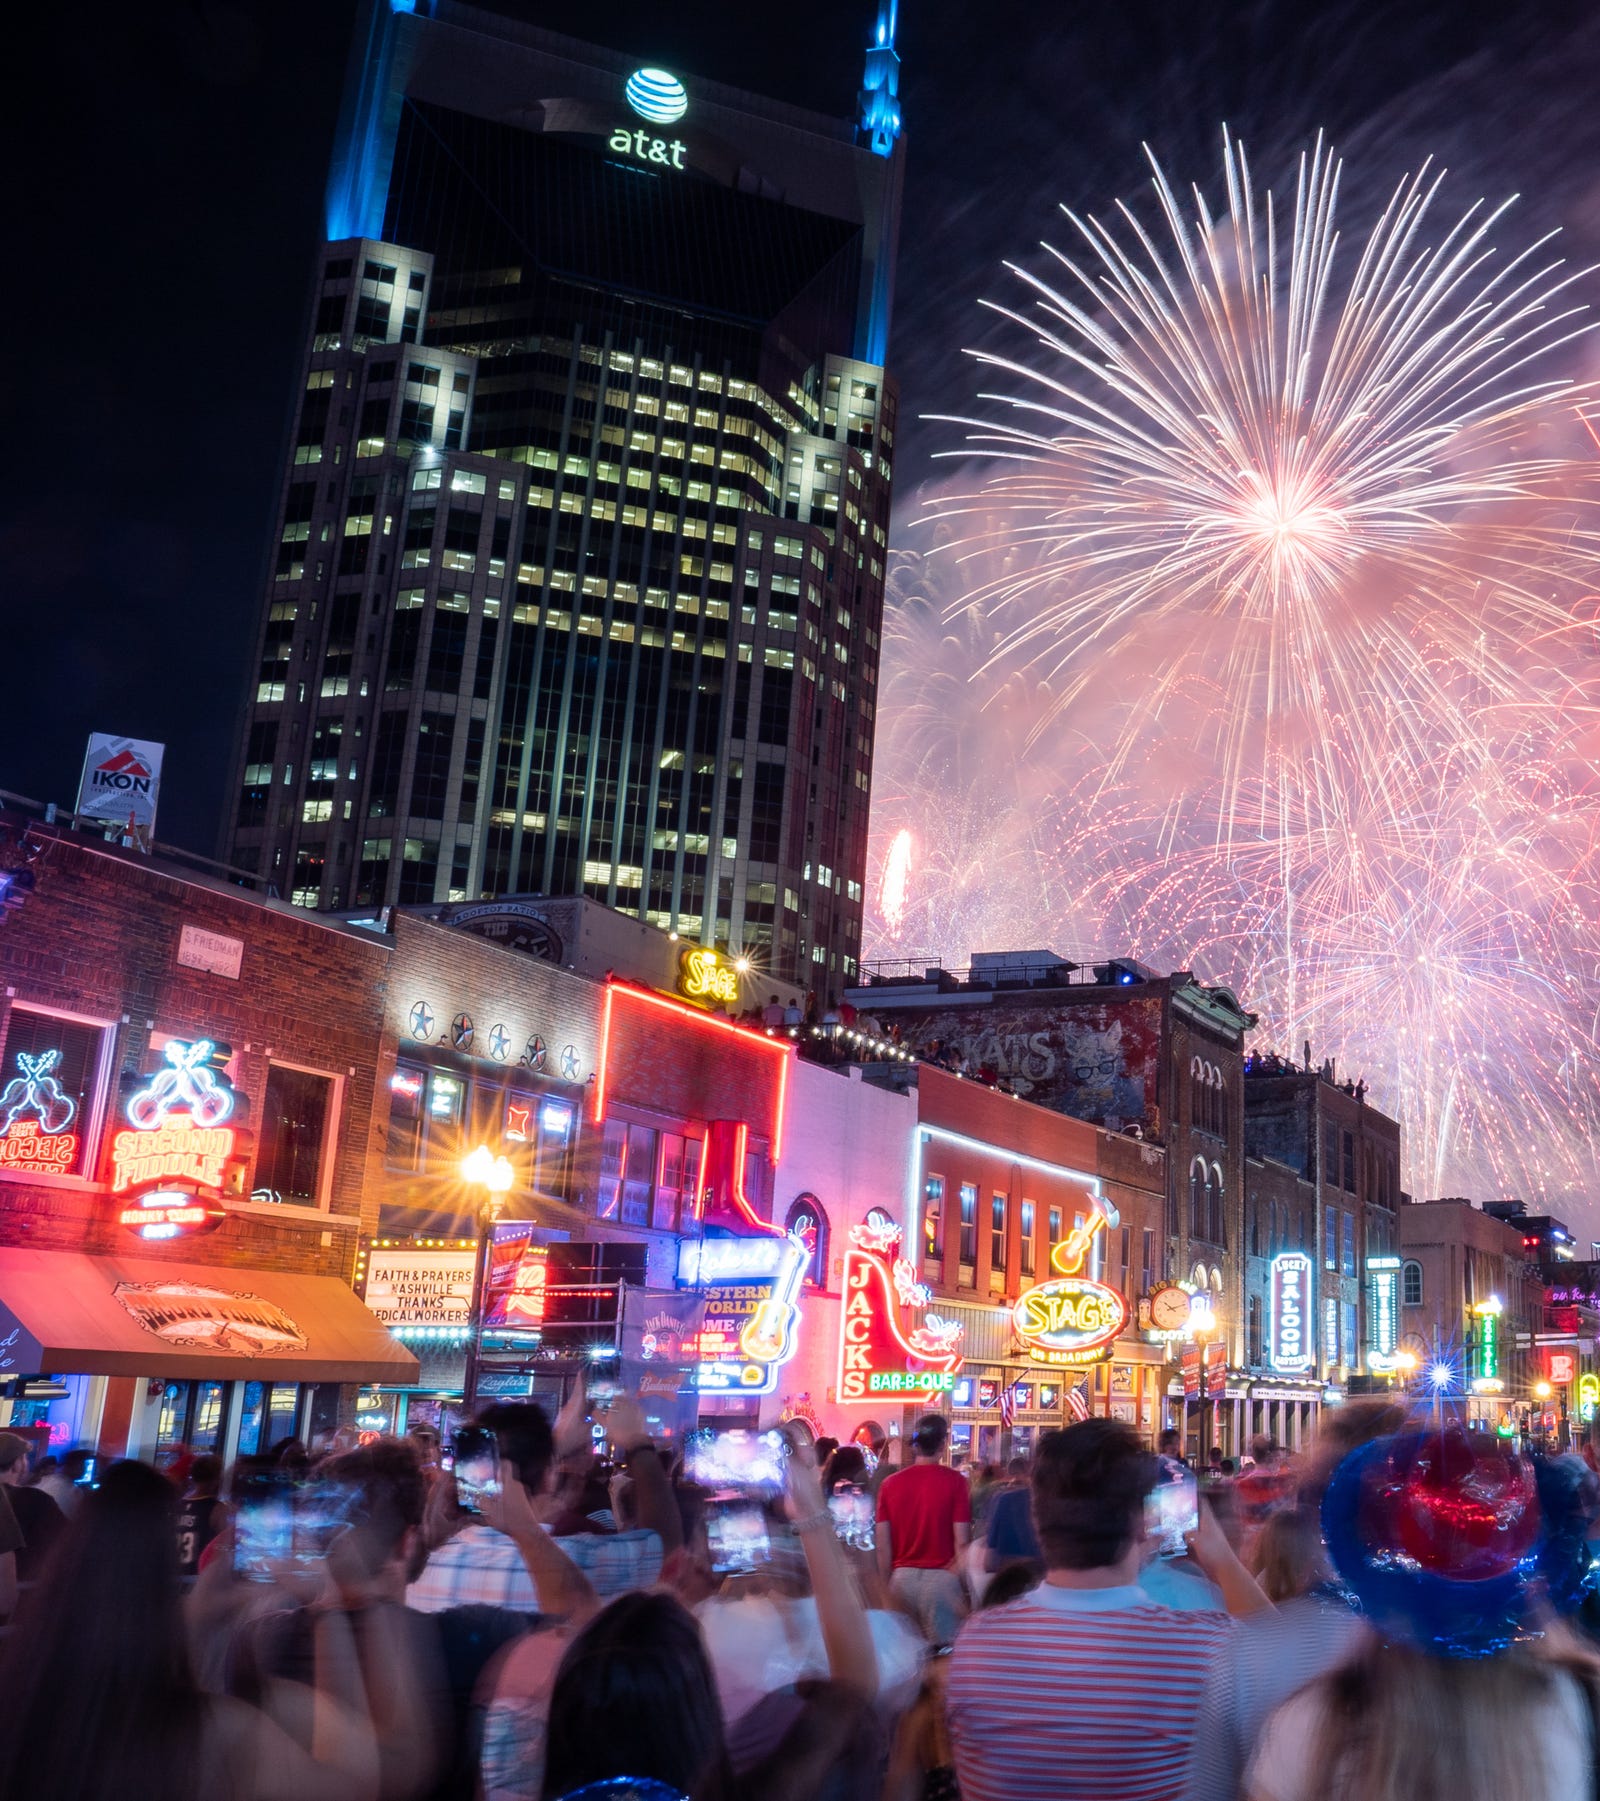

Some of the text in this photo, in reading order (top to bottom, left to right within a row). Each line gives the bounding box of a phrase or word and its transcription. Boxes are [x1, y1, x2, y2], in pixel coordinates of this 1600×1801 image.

[609, 128, 687, 170] at&t
[92, 769, 151, 793] IKON
[114, 1129, 232, 1161] SECOND
[113, 1154, 223, 1192] FIDDLE
[1275, 1260, 1307, 1271] LUCKY
[375, 1270, 472, 1281] FAITH & PRAYERS
[391, 1284, 453, 1294] NASHVILLE
[397, 1297, 444, 1308] THANKS
[414, 1310, 470, 1321] WORKERS
[1021, 1290, 1120, 1336] STAGE
[1280, 1270, 1300, 1356] SALOON
[1149, 1329, 1193, 1341] BOOTS
[1030, 1346, 1105, 1363] ON BROADWAY
[869, 1374, 953, 1391] BAR-B-QUE
